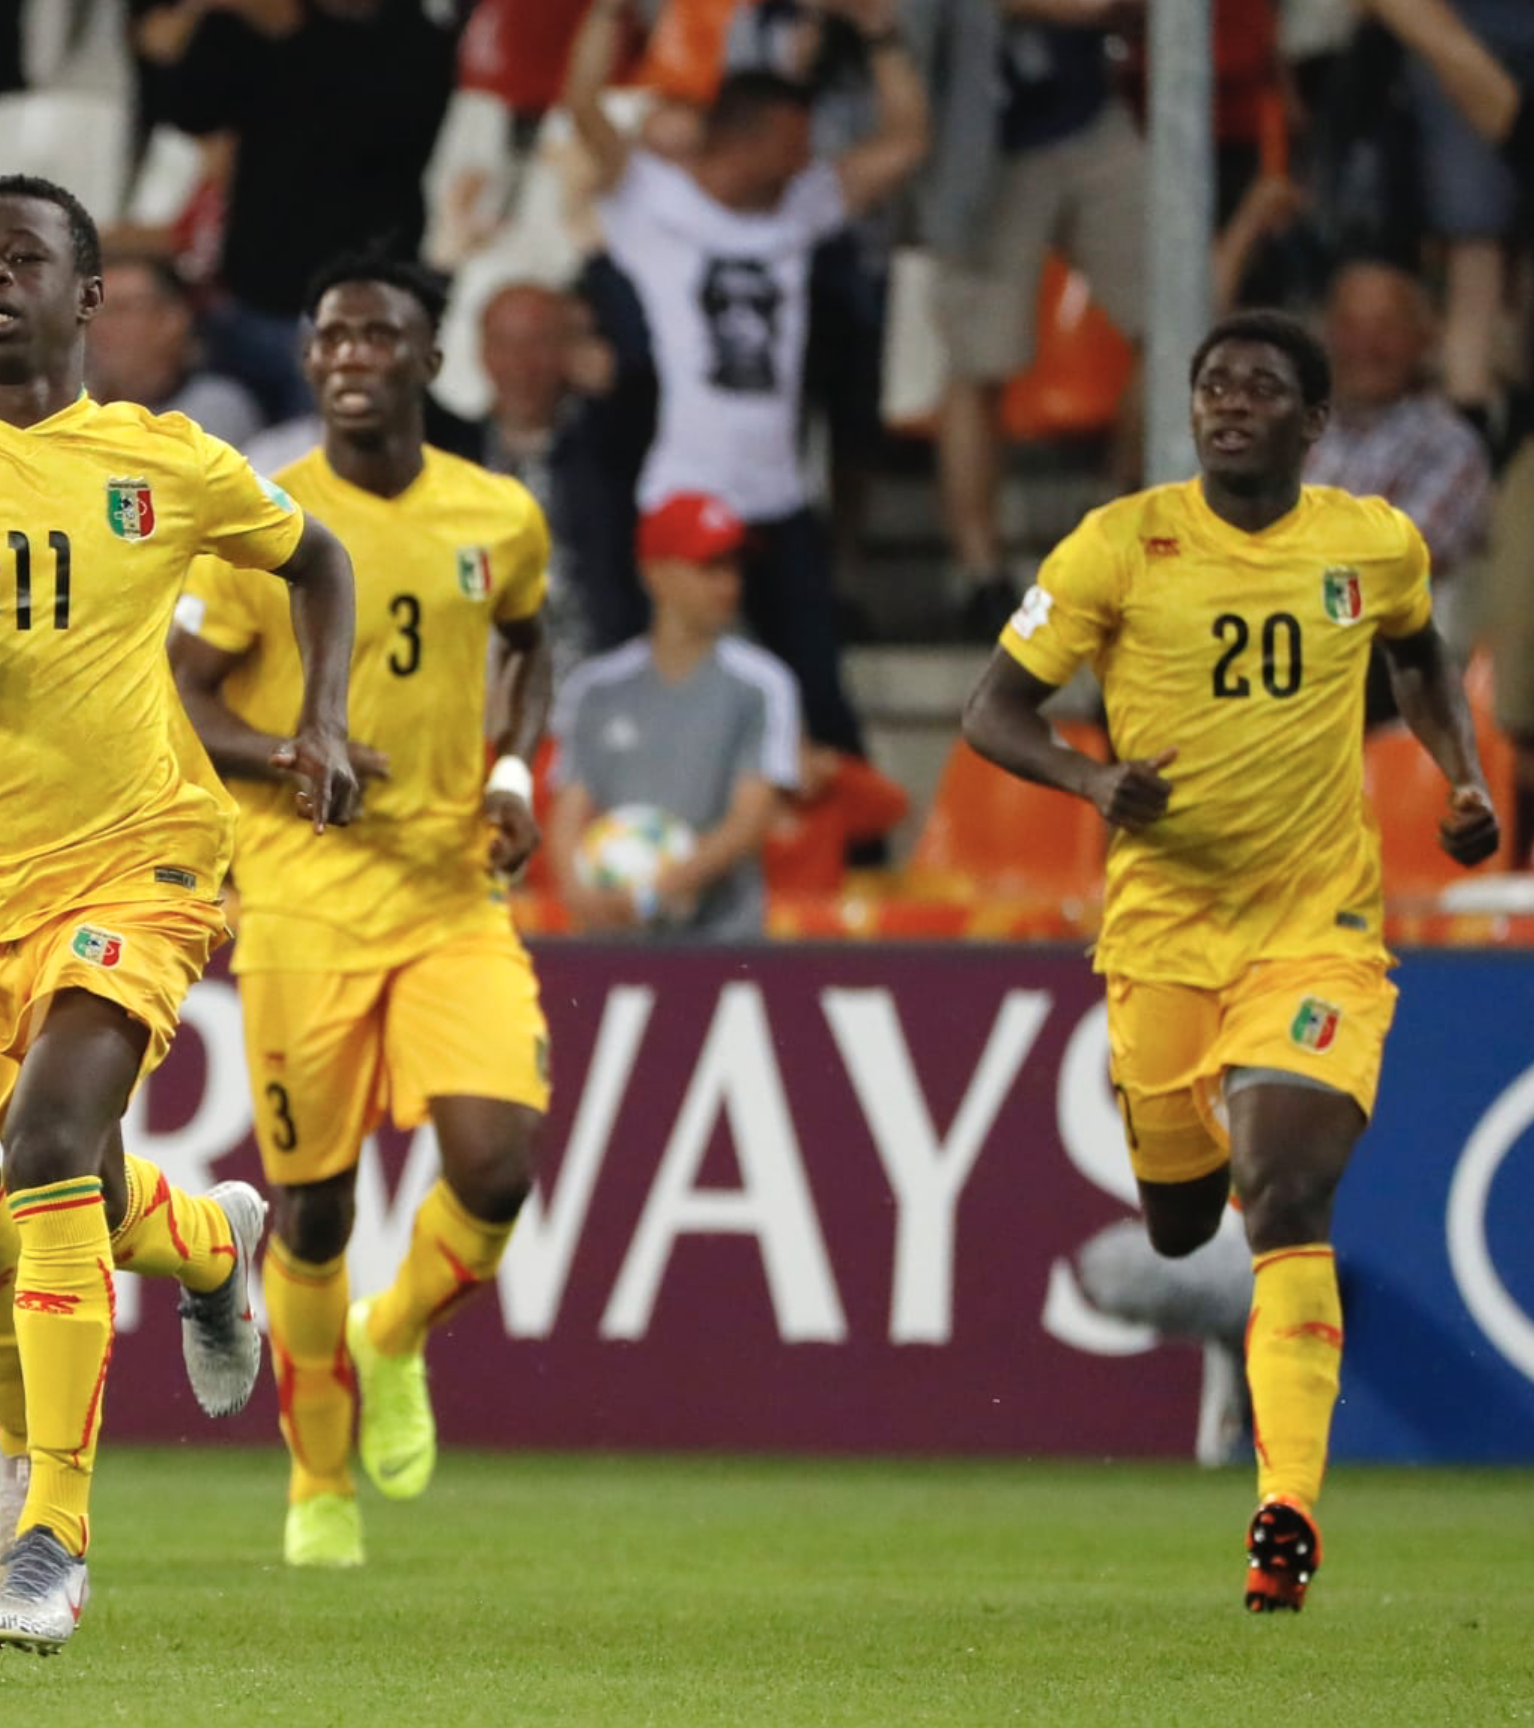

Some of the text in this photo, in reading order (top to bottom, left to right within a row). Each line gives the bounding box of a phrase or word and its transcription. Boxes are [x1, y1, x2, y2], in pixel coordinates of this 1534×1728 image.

[7, 529, 71, 631] 11
[389, 594, 421, 678] 3
[1211, 611, 1302, 699] 20
[265, 1081, 297, 1153] 3
